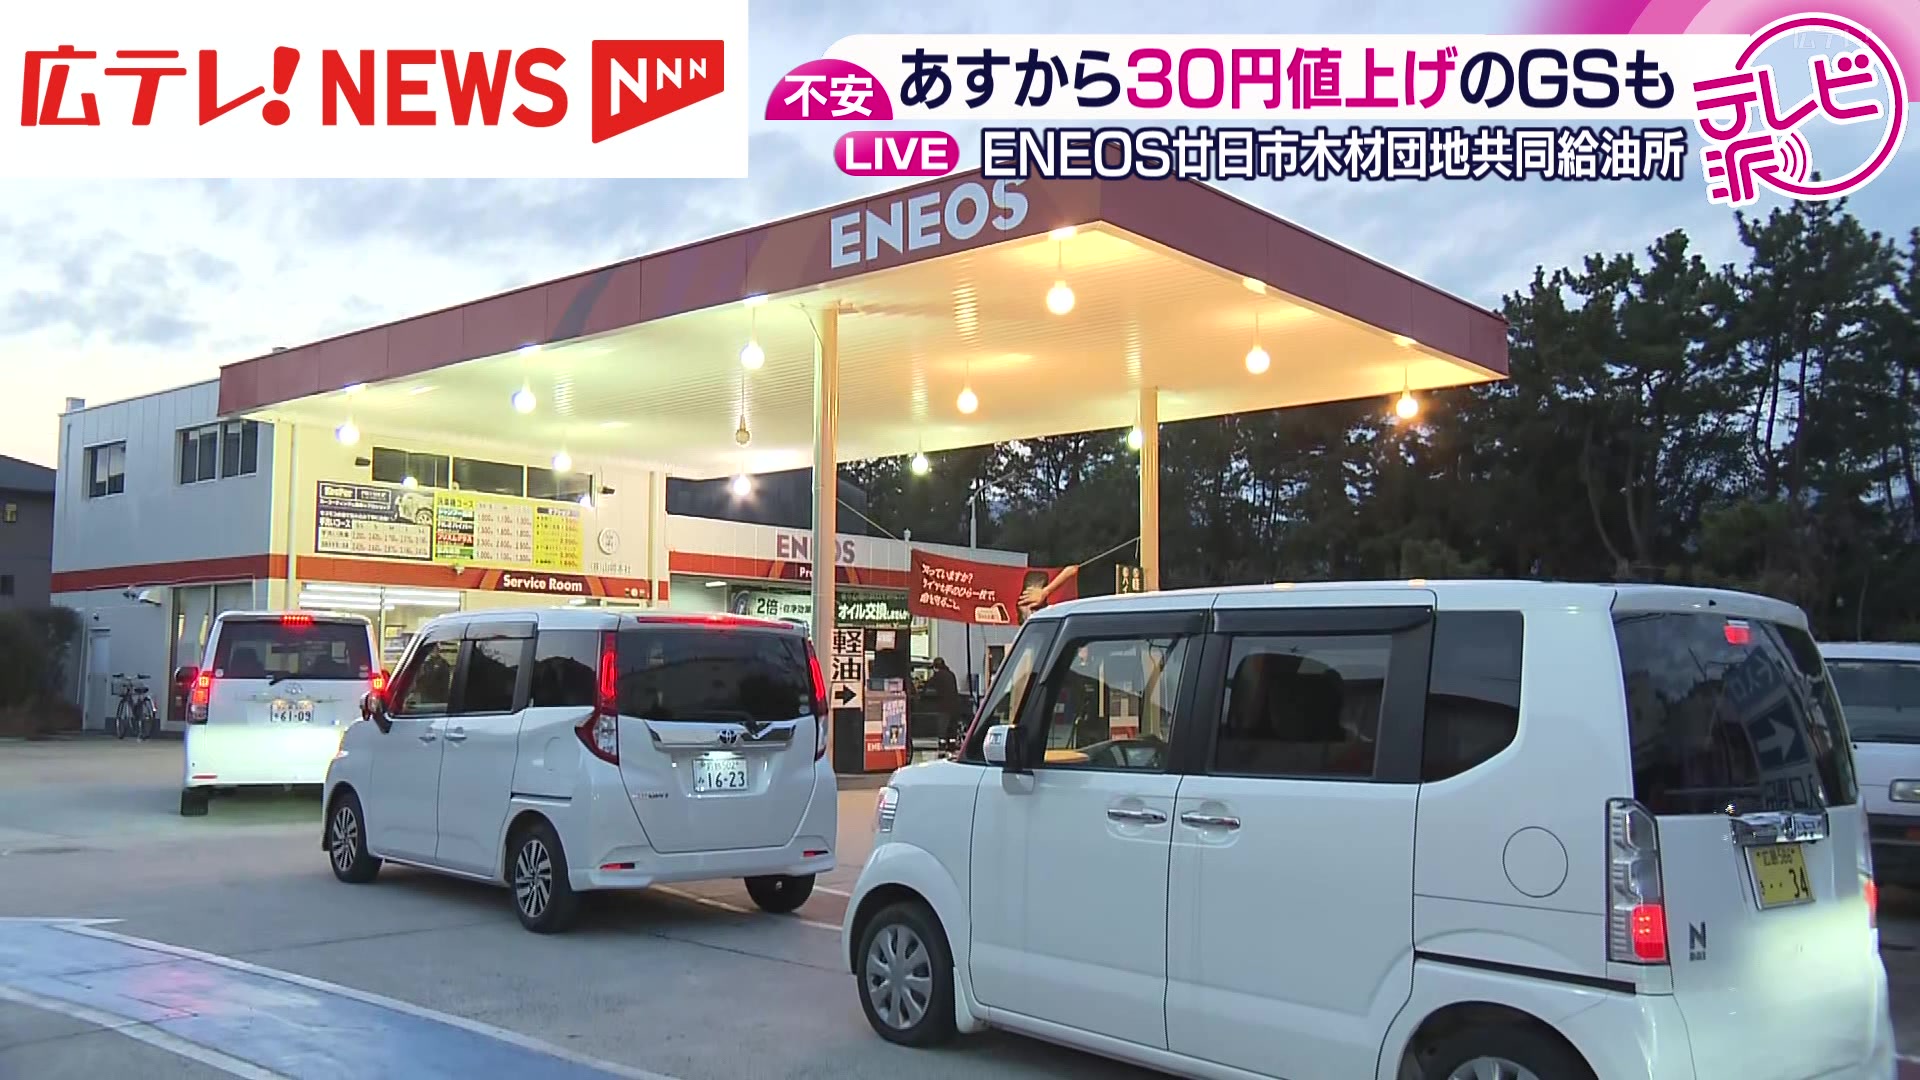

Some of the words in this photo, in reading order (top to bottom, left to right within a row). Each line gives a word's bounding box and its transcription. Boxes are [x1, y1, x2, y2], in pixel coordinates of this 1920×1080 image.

[829, 177, 1030, 270] ENEOS
[777, 534, 855, 564] ENS
[503, 574, 546, 589] Service
[549, 578, 582, 592] Room
[757, 597, 779, 615] 2倍
[832, 630, 862, 680] 軽油
[707, 771, 746, 788] 16-23
[1689, 921, 1706, 950] N
